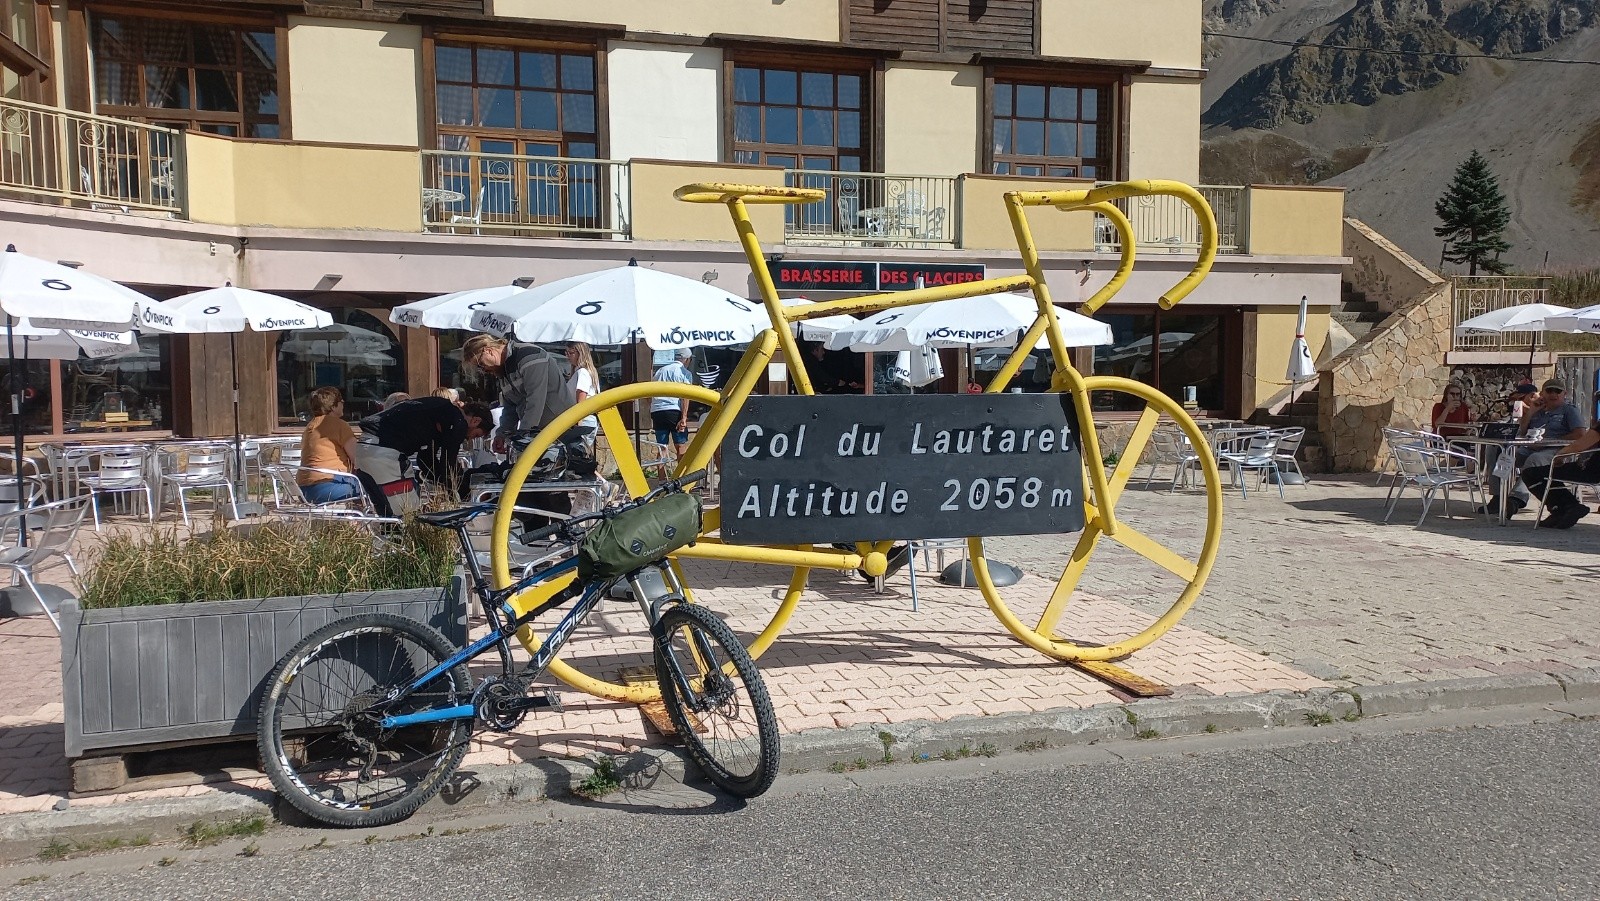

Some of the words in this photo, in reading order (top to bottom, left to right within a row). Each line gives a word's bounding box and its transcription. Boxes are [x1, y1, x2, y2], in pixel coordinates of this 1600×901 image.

[781, 268, 863, 284] BRASSERIE
[881, 270, 908, 284] DES
[738, 424, 806, 458] Col
[837, 422, 882, 457] du
[910, 422, 1072, 455] Lautaret
[737, 480, 909, 519] Altitude
[940, 477, 1044, 512] 2058
[1050, 487, 1073, 508] m
